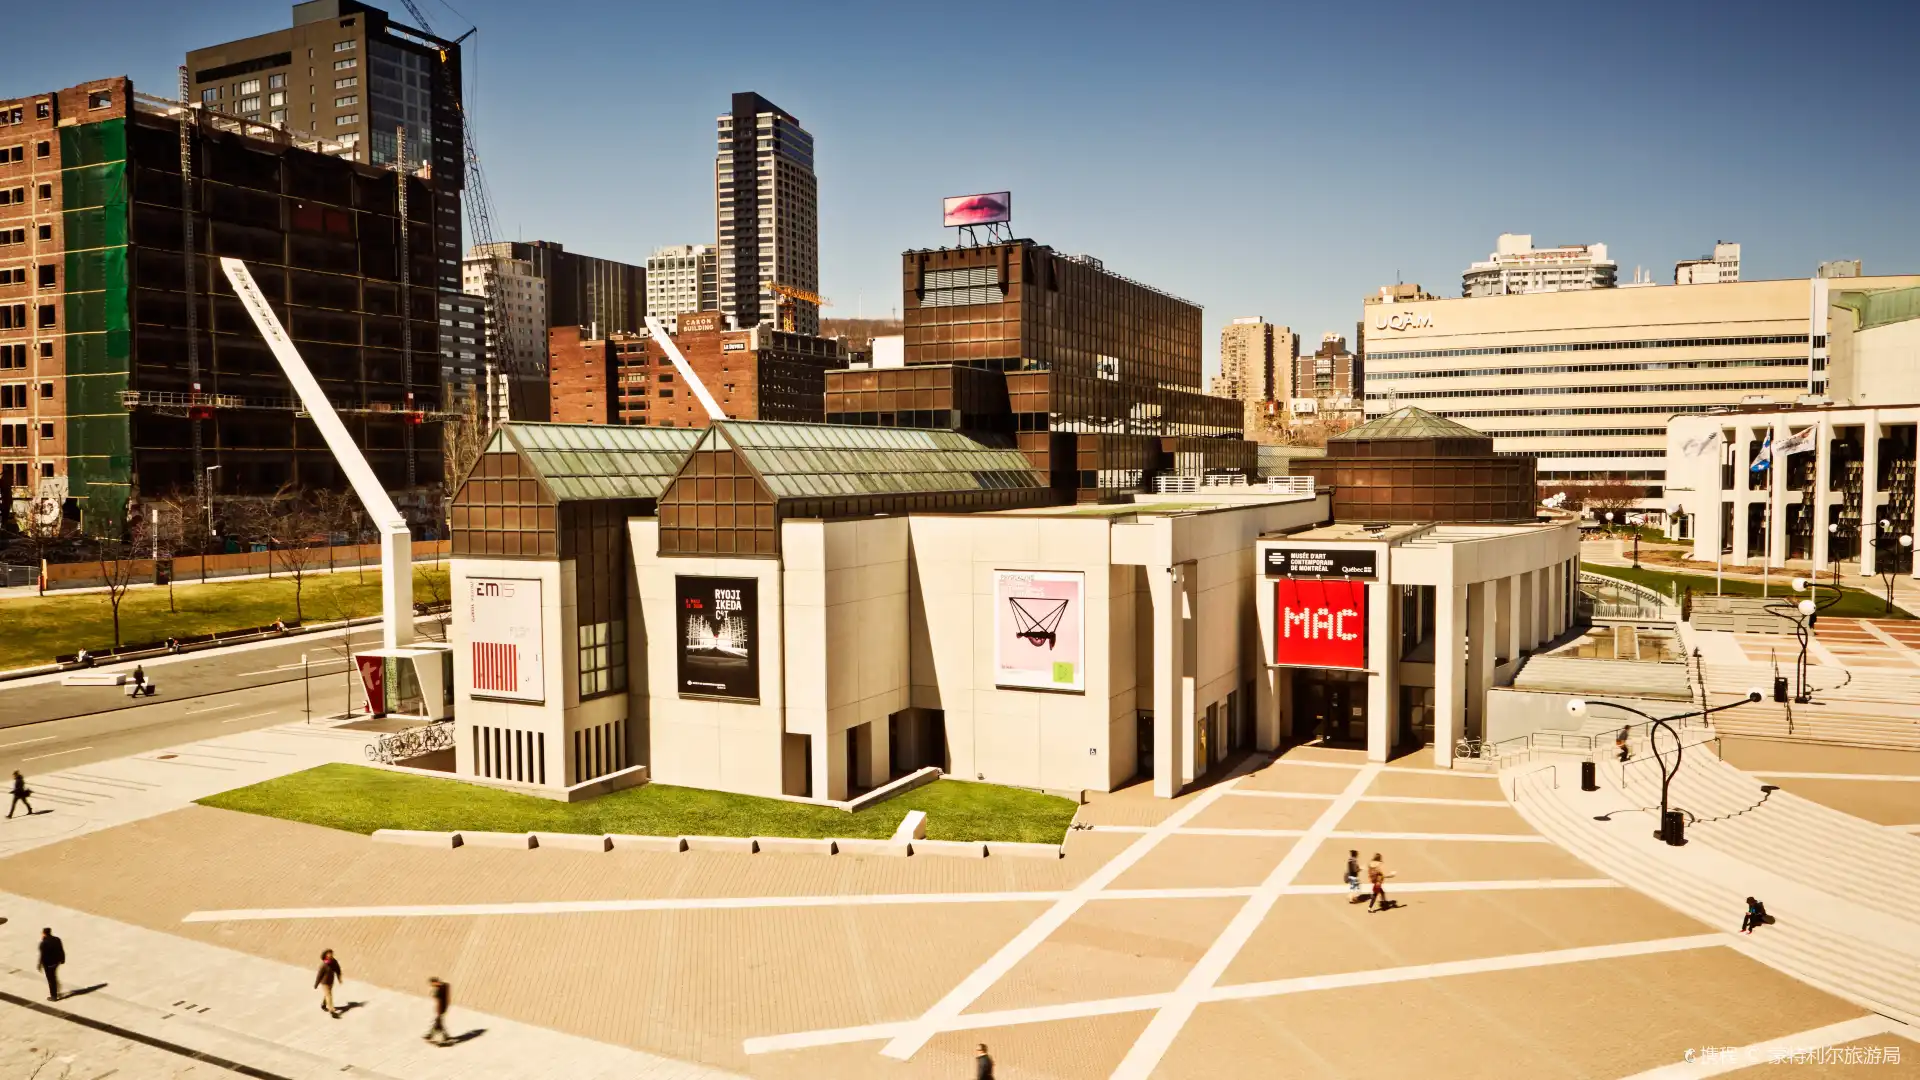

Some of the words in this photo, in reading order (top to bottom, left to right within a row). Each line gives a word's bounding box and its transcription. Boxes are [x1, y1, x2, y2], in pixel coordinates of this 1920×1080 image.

[685, 318, 712, 326] CARON
[683, 324, 714, 332] BUILDING
[1290, 551, 1309, 559] MUSÉE
[714, 588, 741, 600] RYOJI
[715, 599, 742, 611] IKEDA
[1283, 606, 1358, 641] MAC
